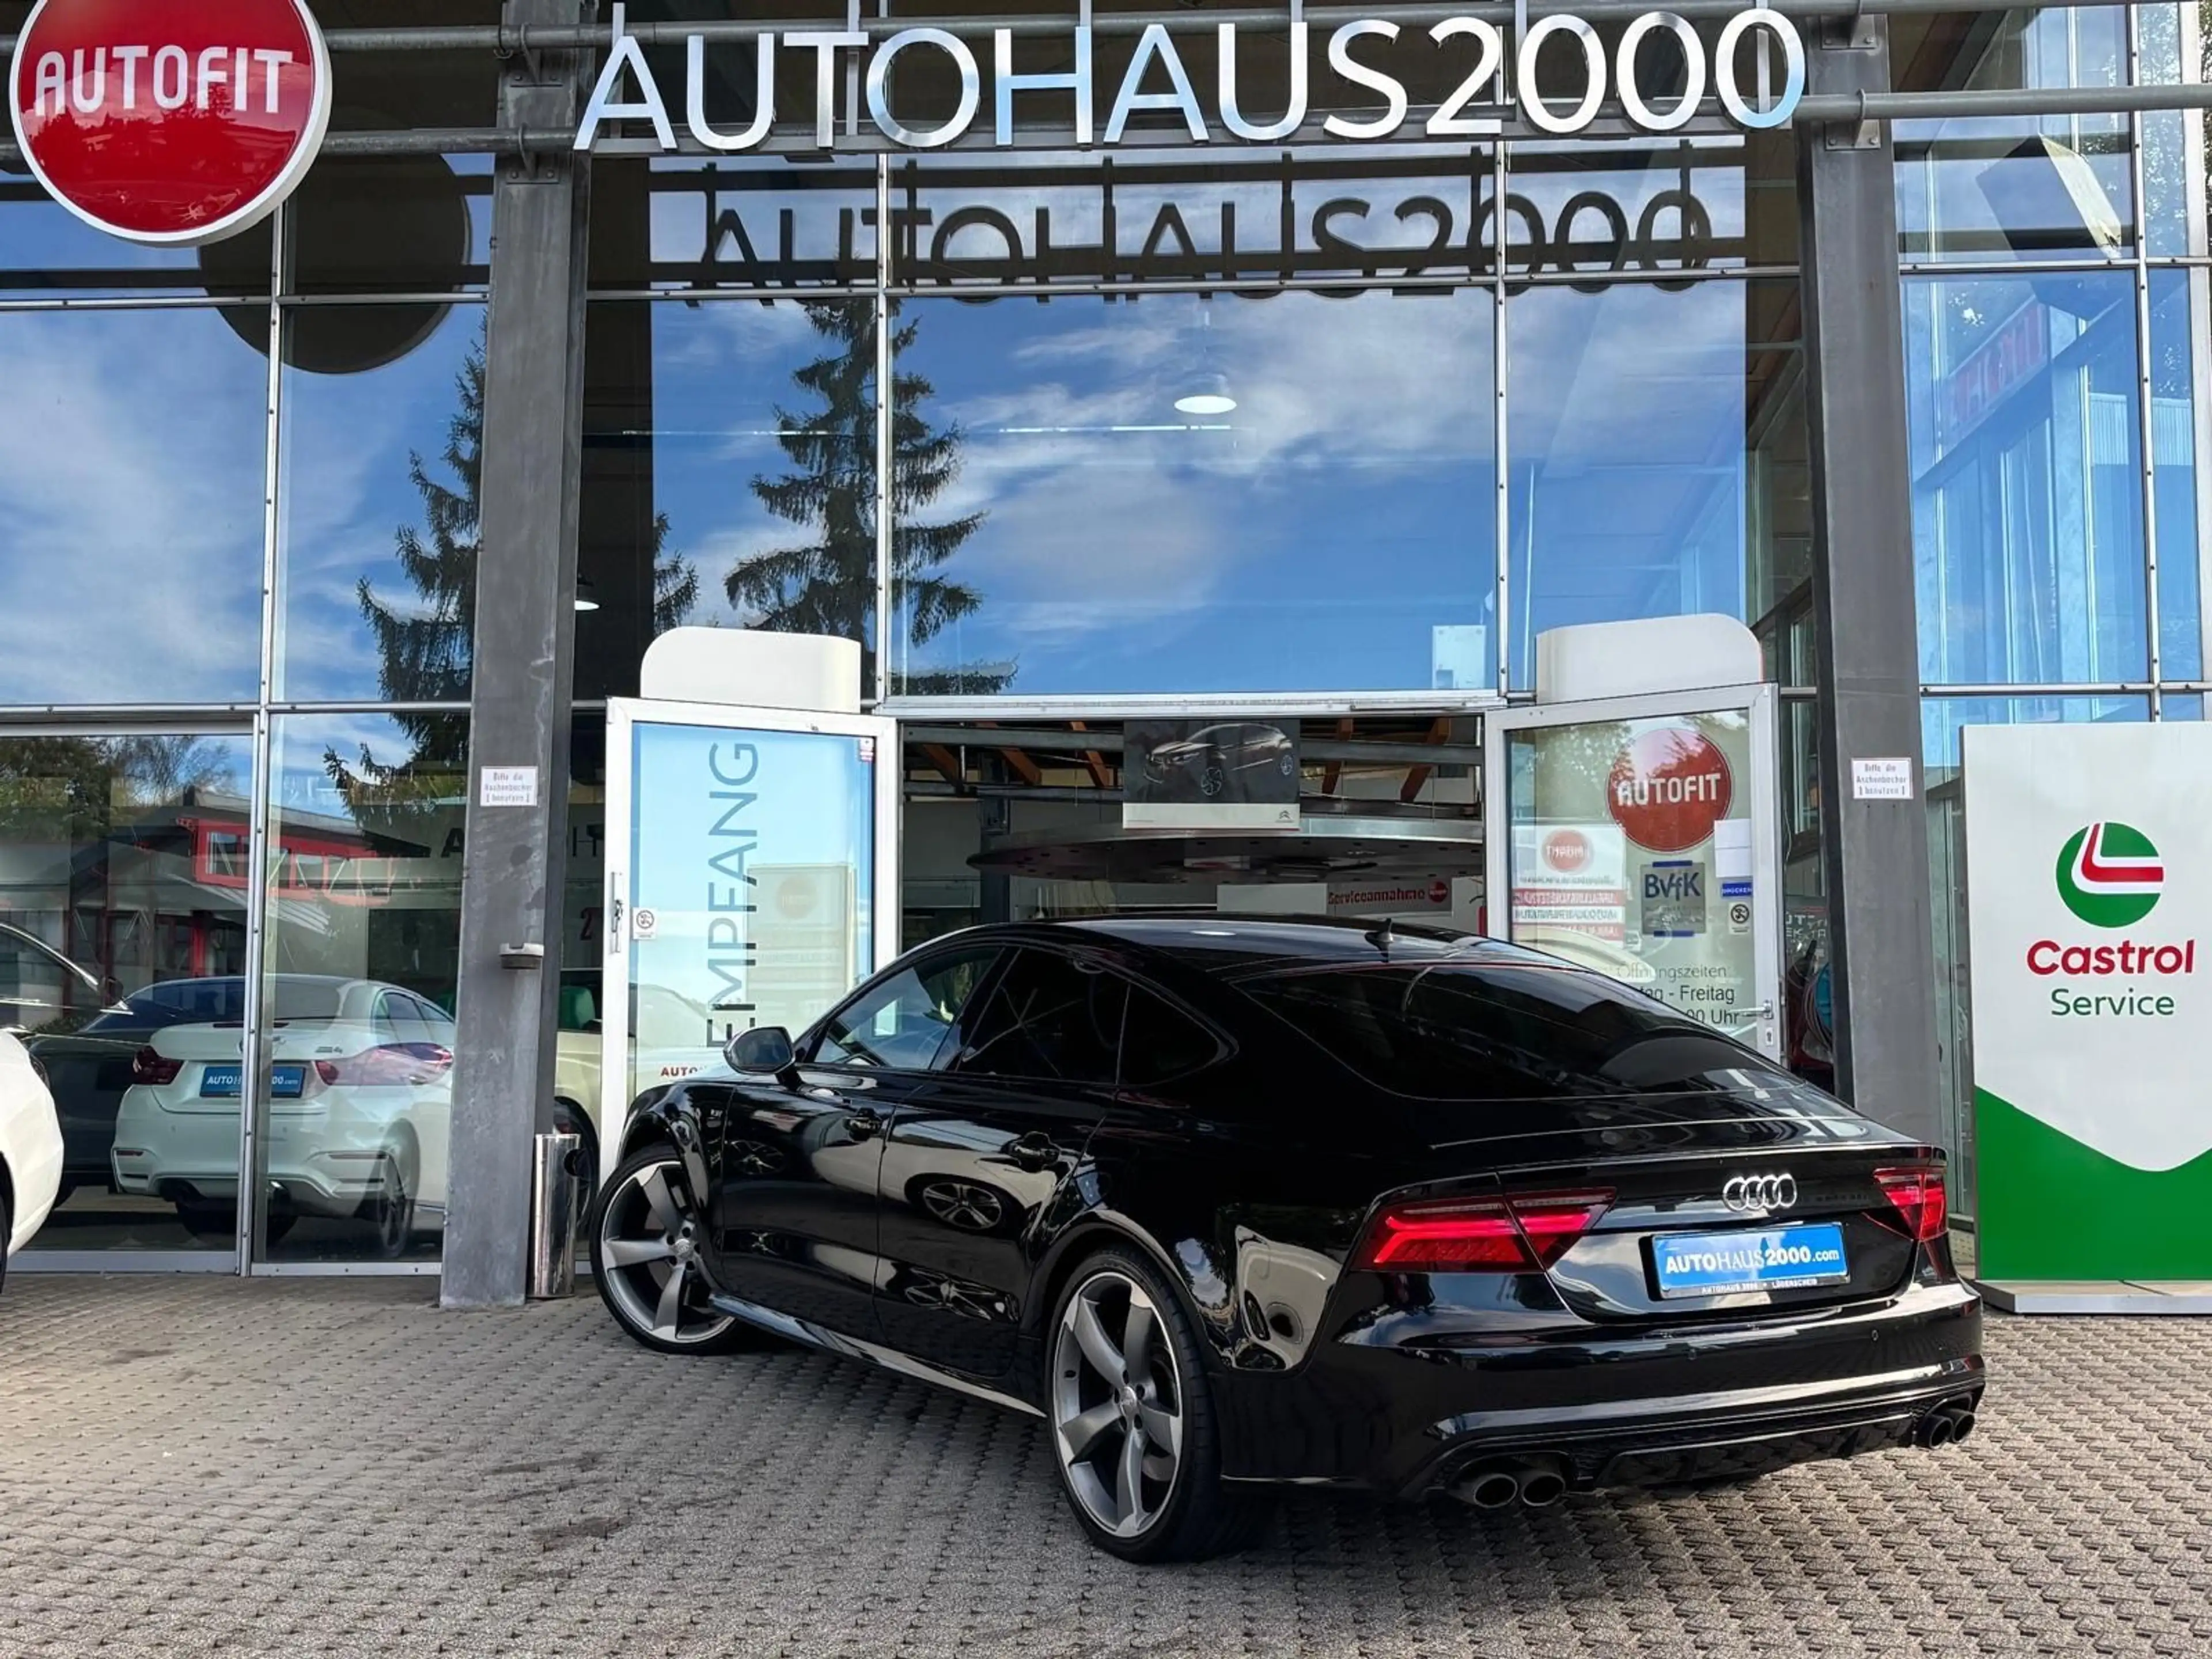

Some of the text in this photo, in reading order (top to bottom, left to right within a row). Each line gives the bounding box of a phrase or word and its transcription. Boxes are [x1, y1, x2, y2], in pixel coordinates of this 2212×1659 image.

[35, 45, 293, 116] AUTOFIT
[573, 8, 1806, 151] AUTOHAUS2000
[1616, 772, 1721, 806] AUTOFIT
[706, 741, 758, 1048] EMPFANG
[1645, 872, 1701, 902] BvfK
[2027, 940, 2195, 975] Castrol
[1680, 985, 1735, 1004] Freitag
[2051, 988, 2175, 1016] Service
[1711, 1009, 1740, 1024] Uhr
[661, 1066, 698, 1076] AUTO
